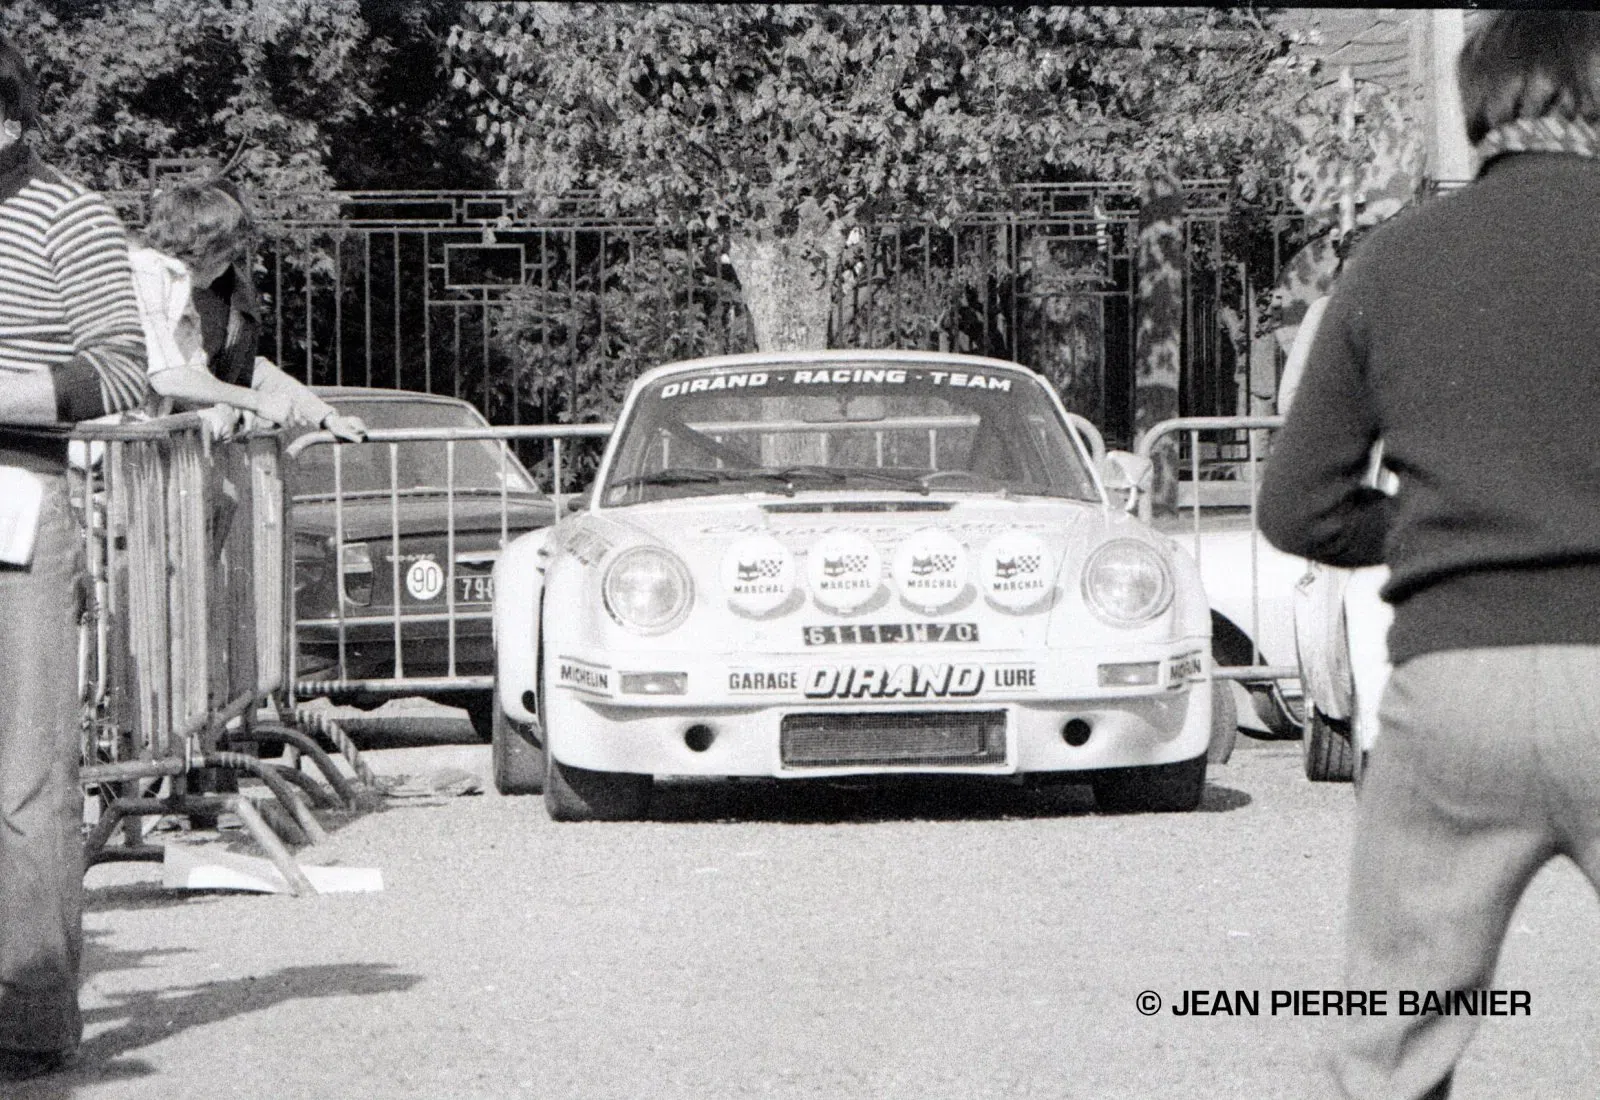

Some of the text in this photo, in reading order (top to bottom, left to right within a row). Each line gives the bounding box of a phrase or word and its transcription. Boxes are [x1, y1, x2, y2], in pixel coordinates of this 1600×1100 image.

[661, 369, 1012, 399] DIRAND RACING TEAM
[413, 566, 438, 593] 90
[733, 584, 784, 594] MARCHAL
[820, 580, 872, 590] MARCHAL
[907, 579, 958, 589] MARCHAL
[993, 579, 1045, 591] MARCHAL
[809, 625, 882, 645] 6111
[935, 623, 972, 642] 70
[560, 664, 609, 689] MICHELIN
[729, 664, 1036, 699] GARAGE DIRAND LURE
